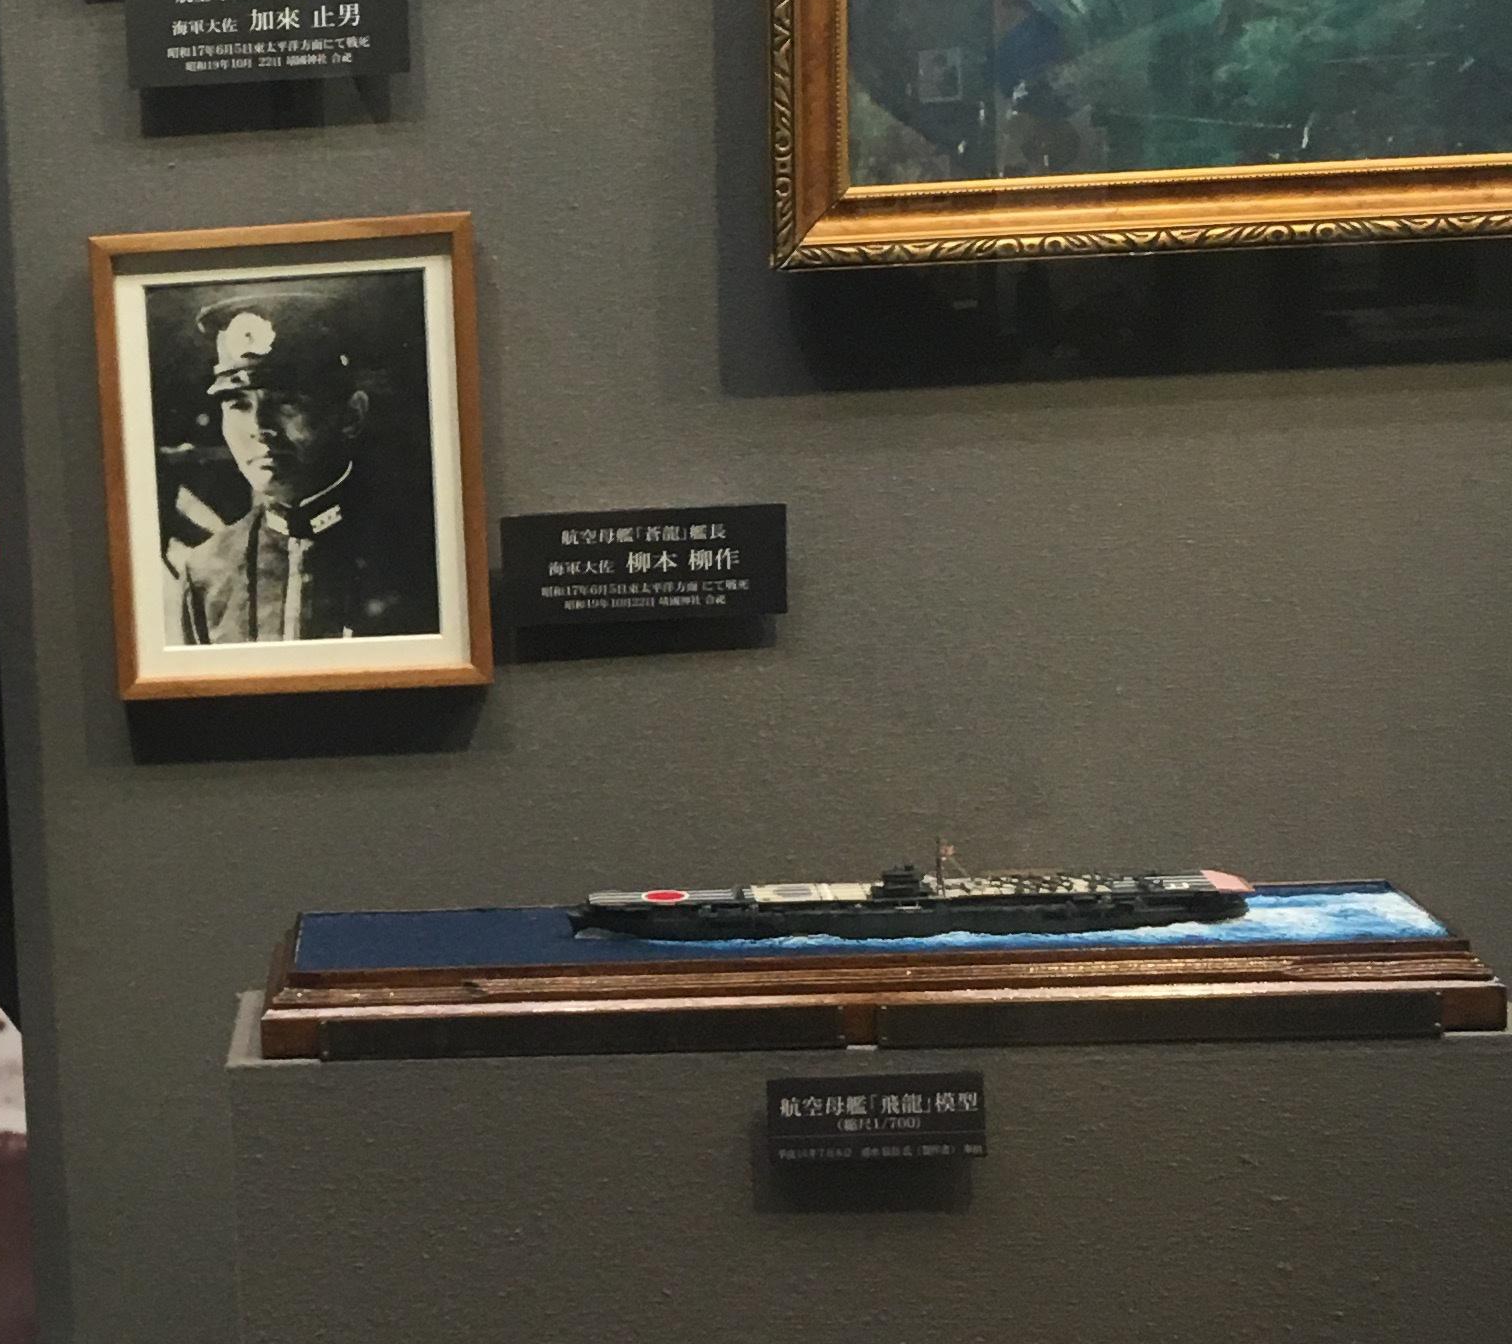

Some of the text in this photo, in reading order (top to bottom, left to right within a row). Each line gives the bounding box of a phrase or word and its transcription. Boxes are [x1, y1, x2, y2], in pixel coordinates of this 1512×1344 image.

[171, 16, 238, 37] 海軍大佐
[310, 2, 361, 29] 止男
[548, 547, 740, 577] 海軍大佐 柳本 柳作
[779, 1091, 979, 1118] 航空母艦「飛龍」模型
